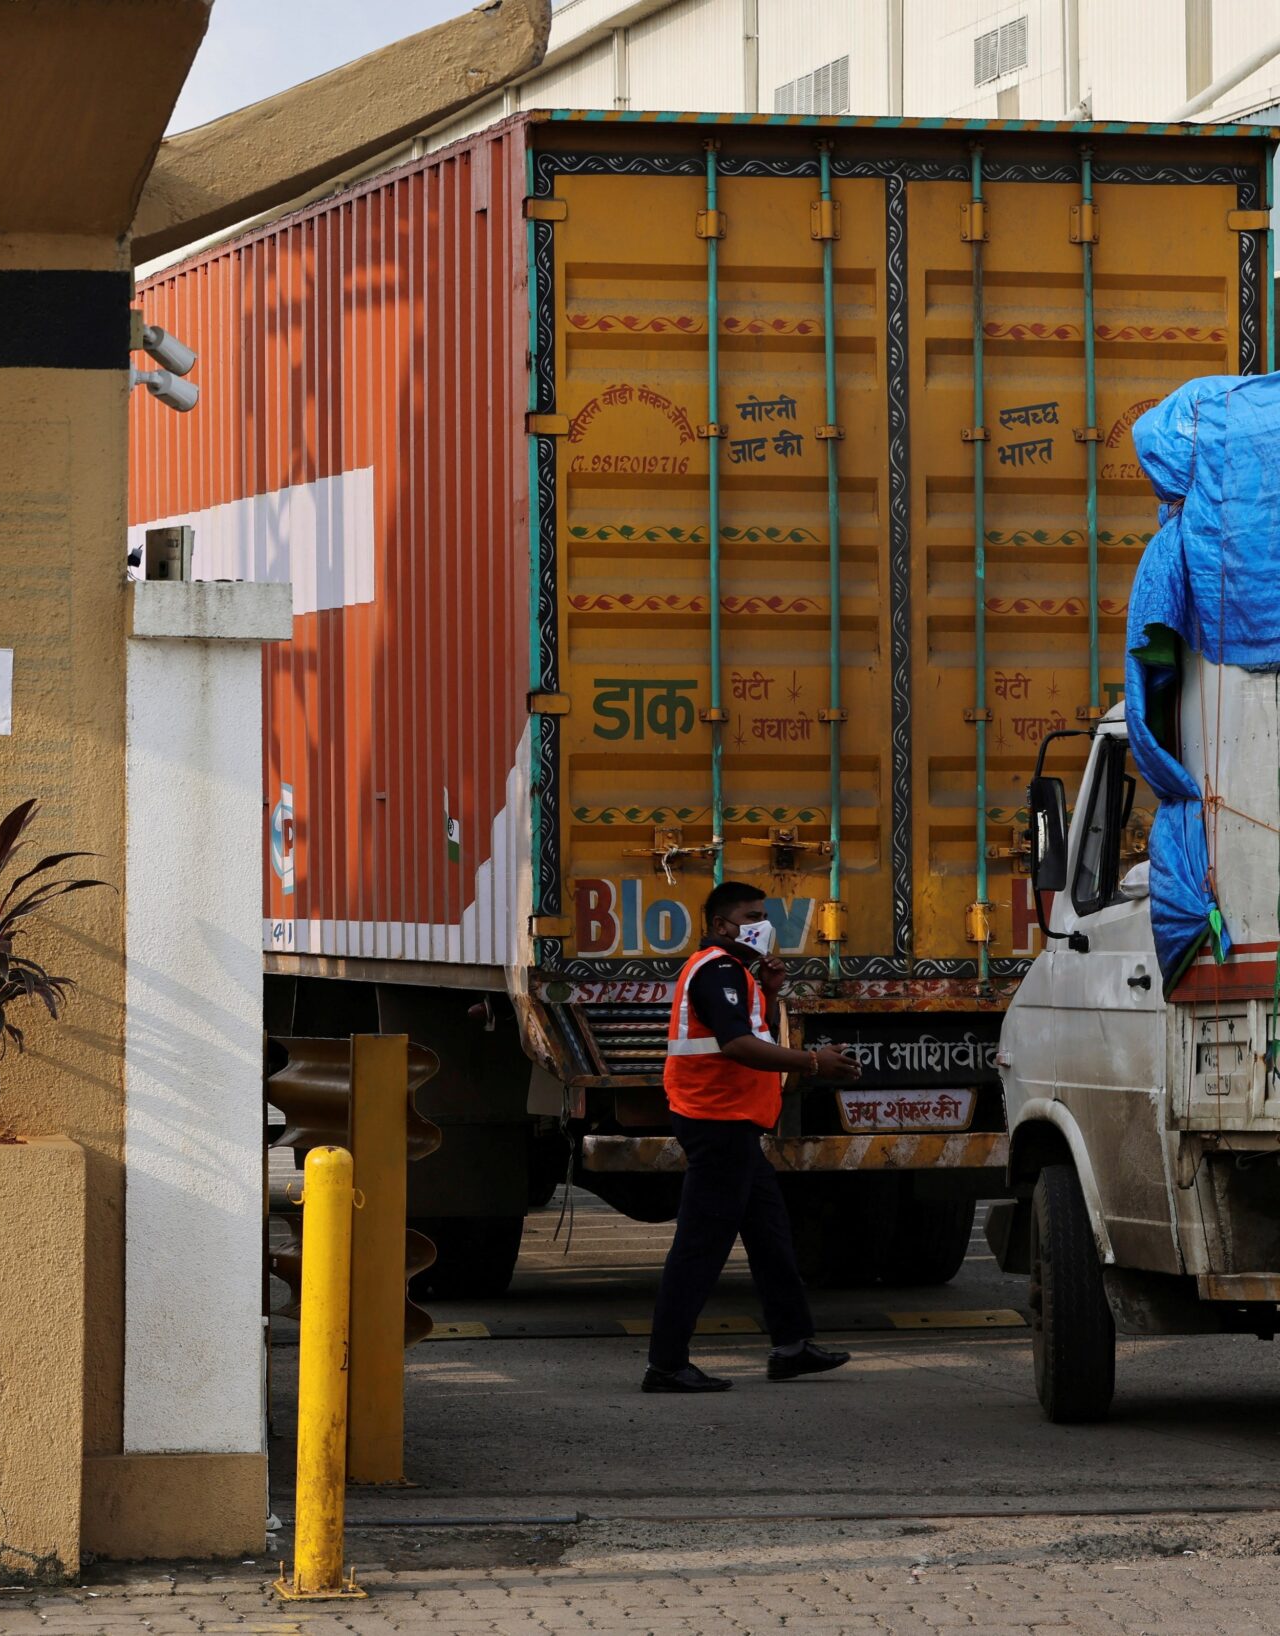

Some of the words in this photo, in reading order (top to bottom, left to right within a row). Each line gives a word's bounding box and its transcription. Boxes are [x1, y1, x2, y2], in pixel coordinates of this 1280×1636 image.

[637, 384, 672, 412] मेकर
[735, 393, 797, 422] मोरनी
[999, 401, 1060, 431] स्वच्छ
[727, 437, 768, 464] जाट
[771, 428, 805, 458] की
[997, 437, 1054, 467] भारत
[731, 670, 775, 701] बेटी
[993, 671, 1032, 700] बेटी
[592, 678, 698, 741] डाक
[751, 711, 814, 742] बचाओ
[576, 981, 669, 1003] SPEED
